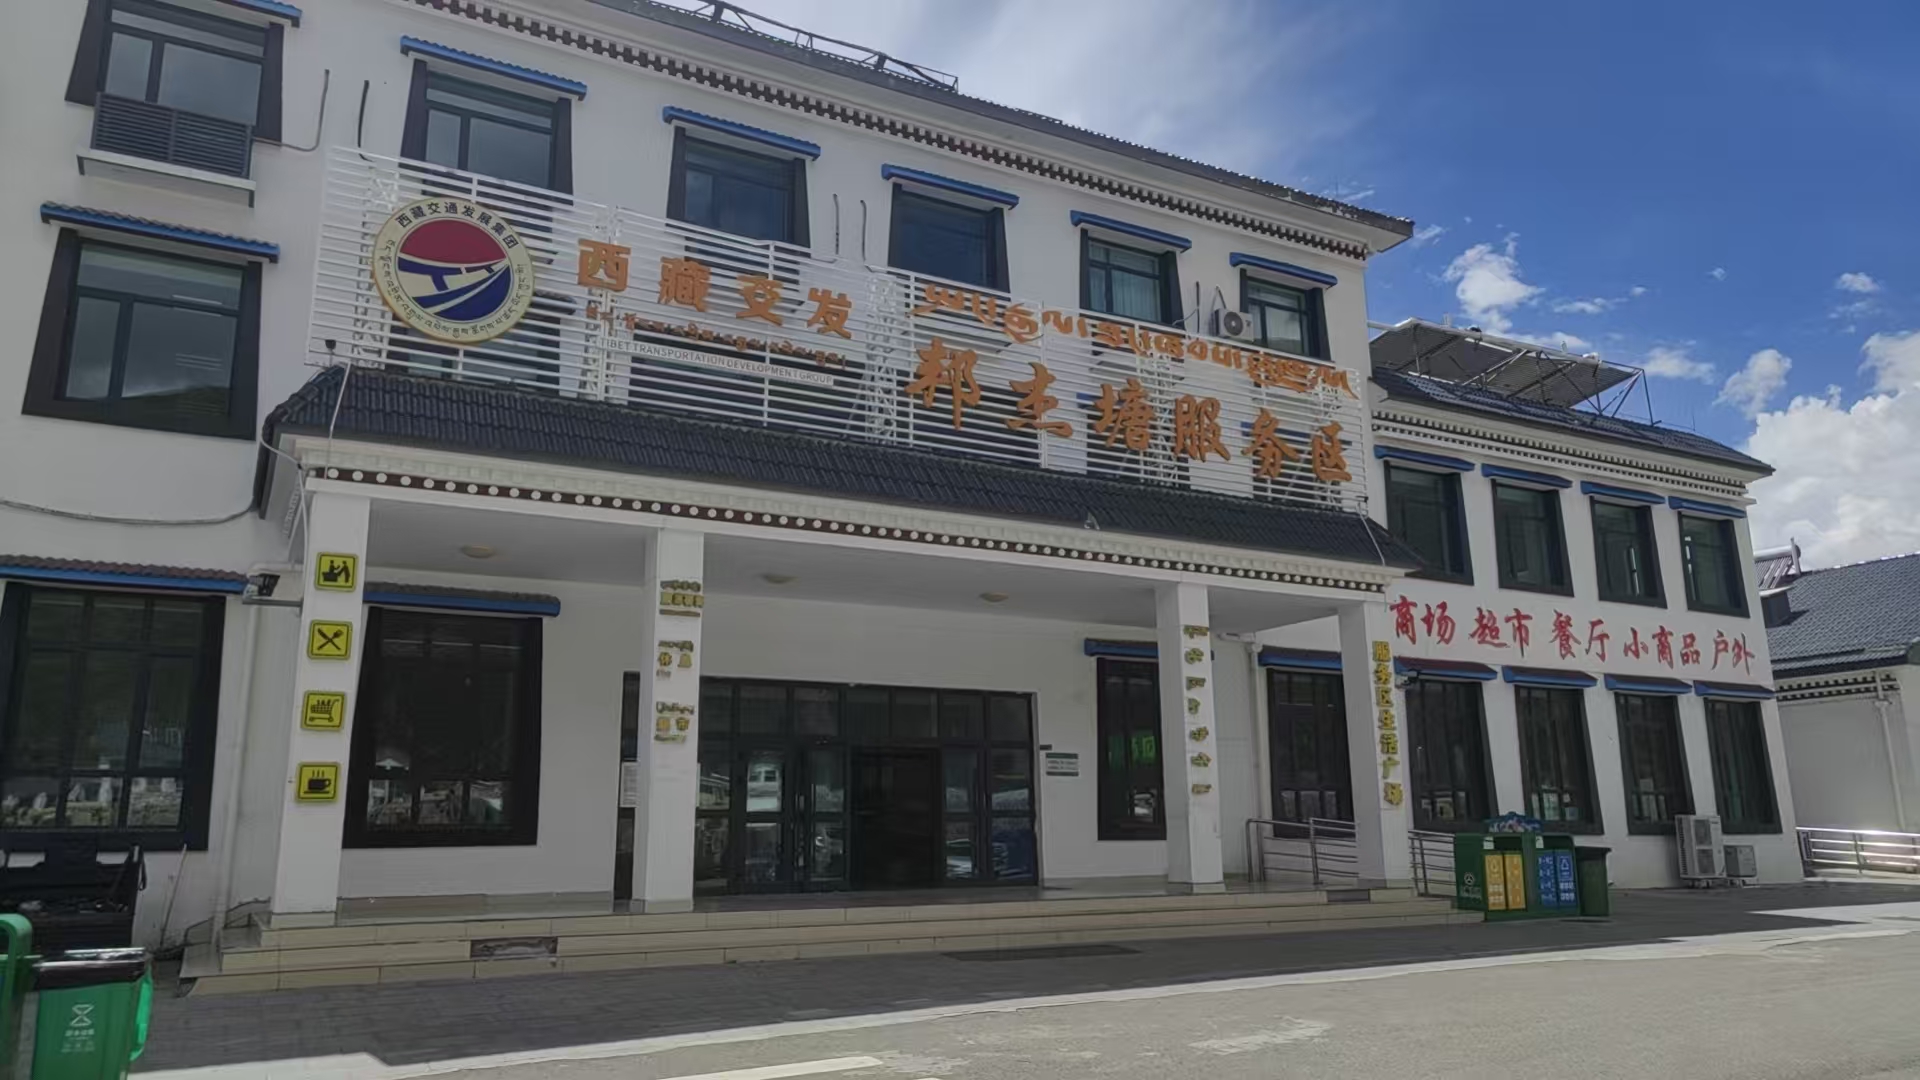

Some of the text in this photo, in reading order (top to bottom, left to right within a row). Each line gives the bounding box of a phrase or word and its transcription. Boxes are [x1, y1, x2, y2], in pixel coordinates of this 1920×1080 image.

[395, 201, 519, 249] 西藏交通发展集团
[577, 238, 853, 339] 西藏交发
[600, 338, 833, 385] TIBET TRANSPORTATION DEVELOPMENT GROUP
[905, 337, 1353, 482] 邦杰塘服务区
[1390, 595, 1756, 675] 商场 超市 餐厅 小商品 户外
